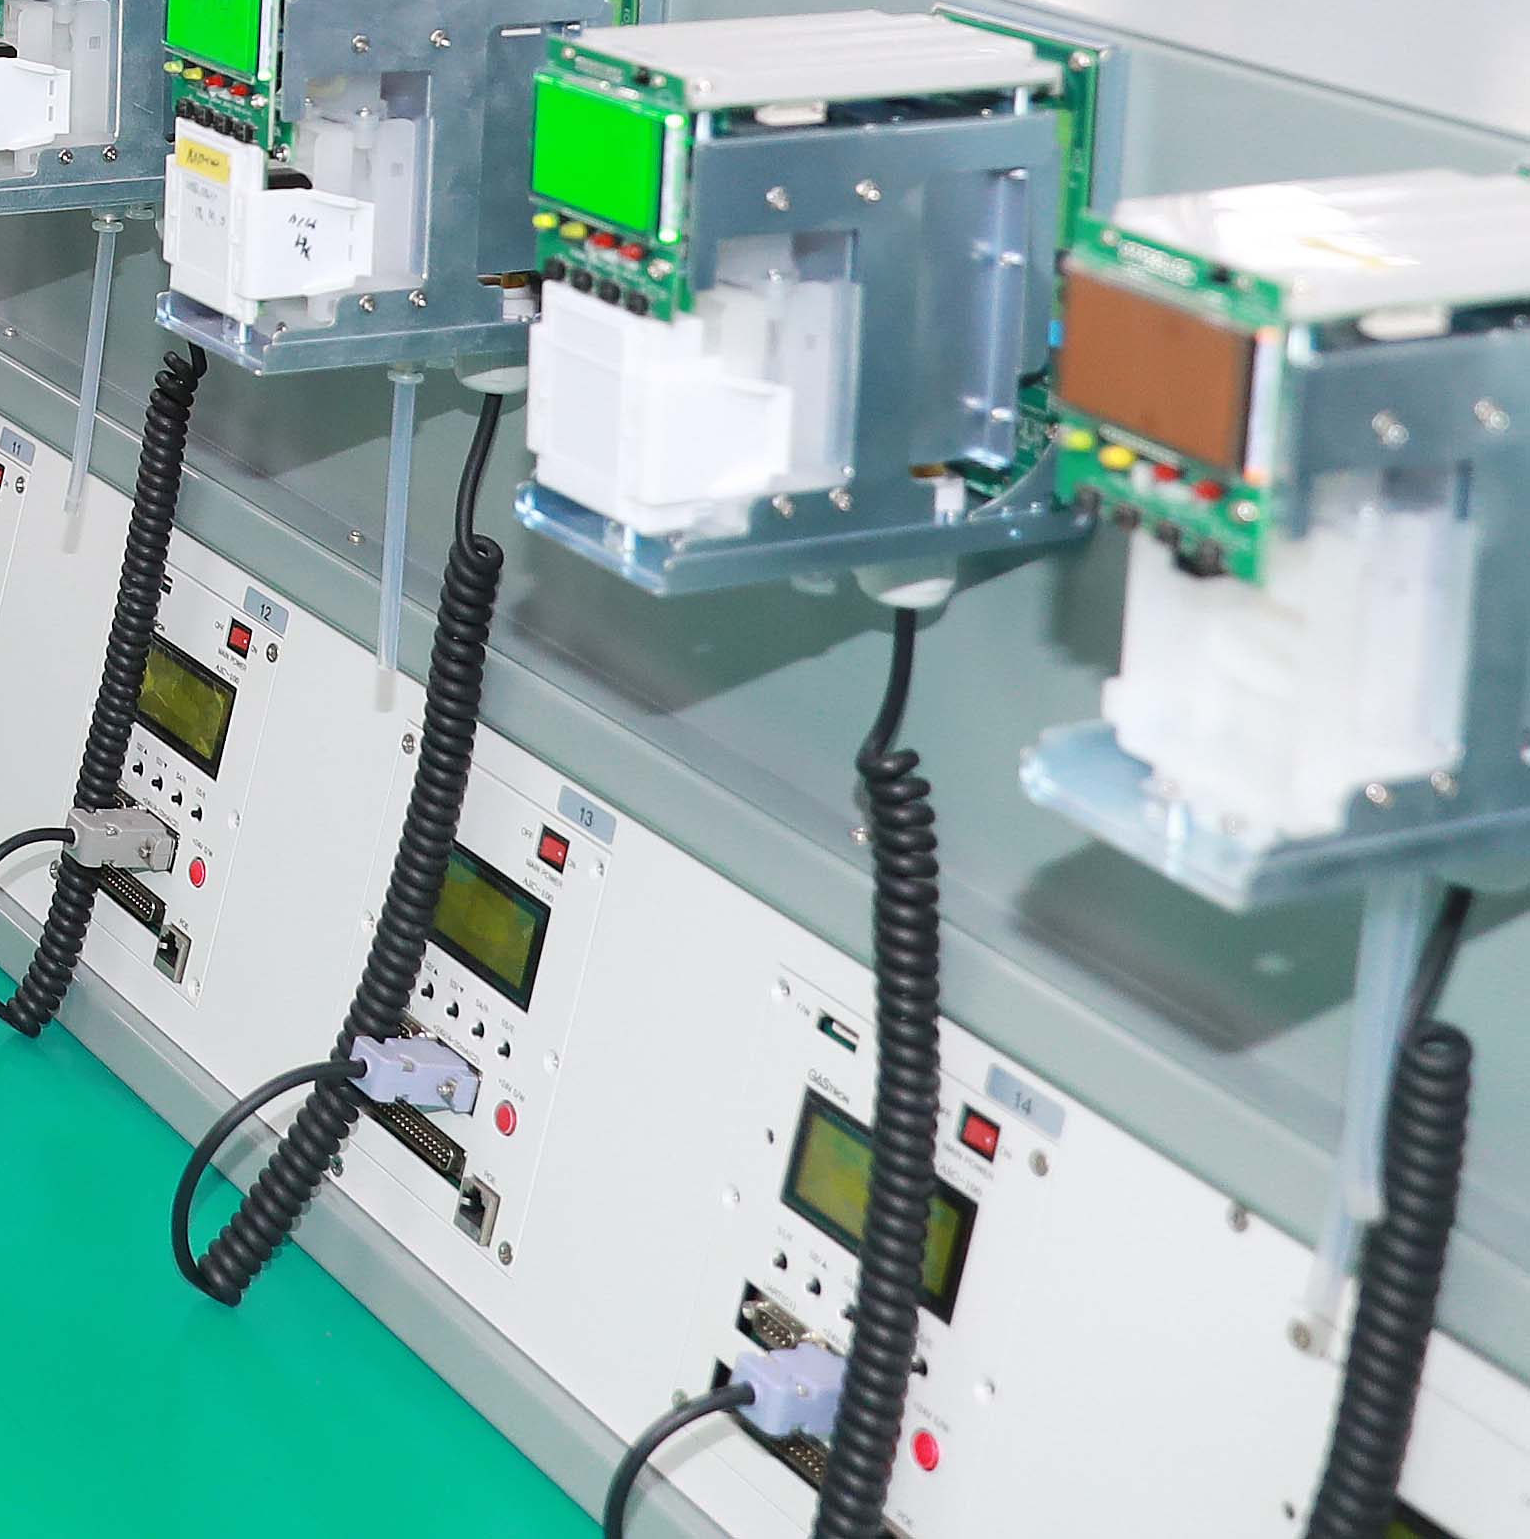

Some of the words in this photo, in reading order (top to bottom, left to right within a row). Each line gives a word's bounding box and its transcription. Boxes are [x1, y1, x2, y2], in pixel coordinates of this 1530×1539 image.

[12, 441, 21, 456] 11
[260, 604, 273, 622] 12
[579, 806, 595, 828] 13
[1014, 1092, 1033, 1116] 14
